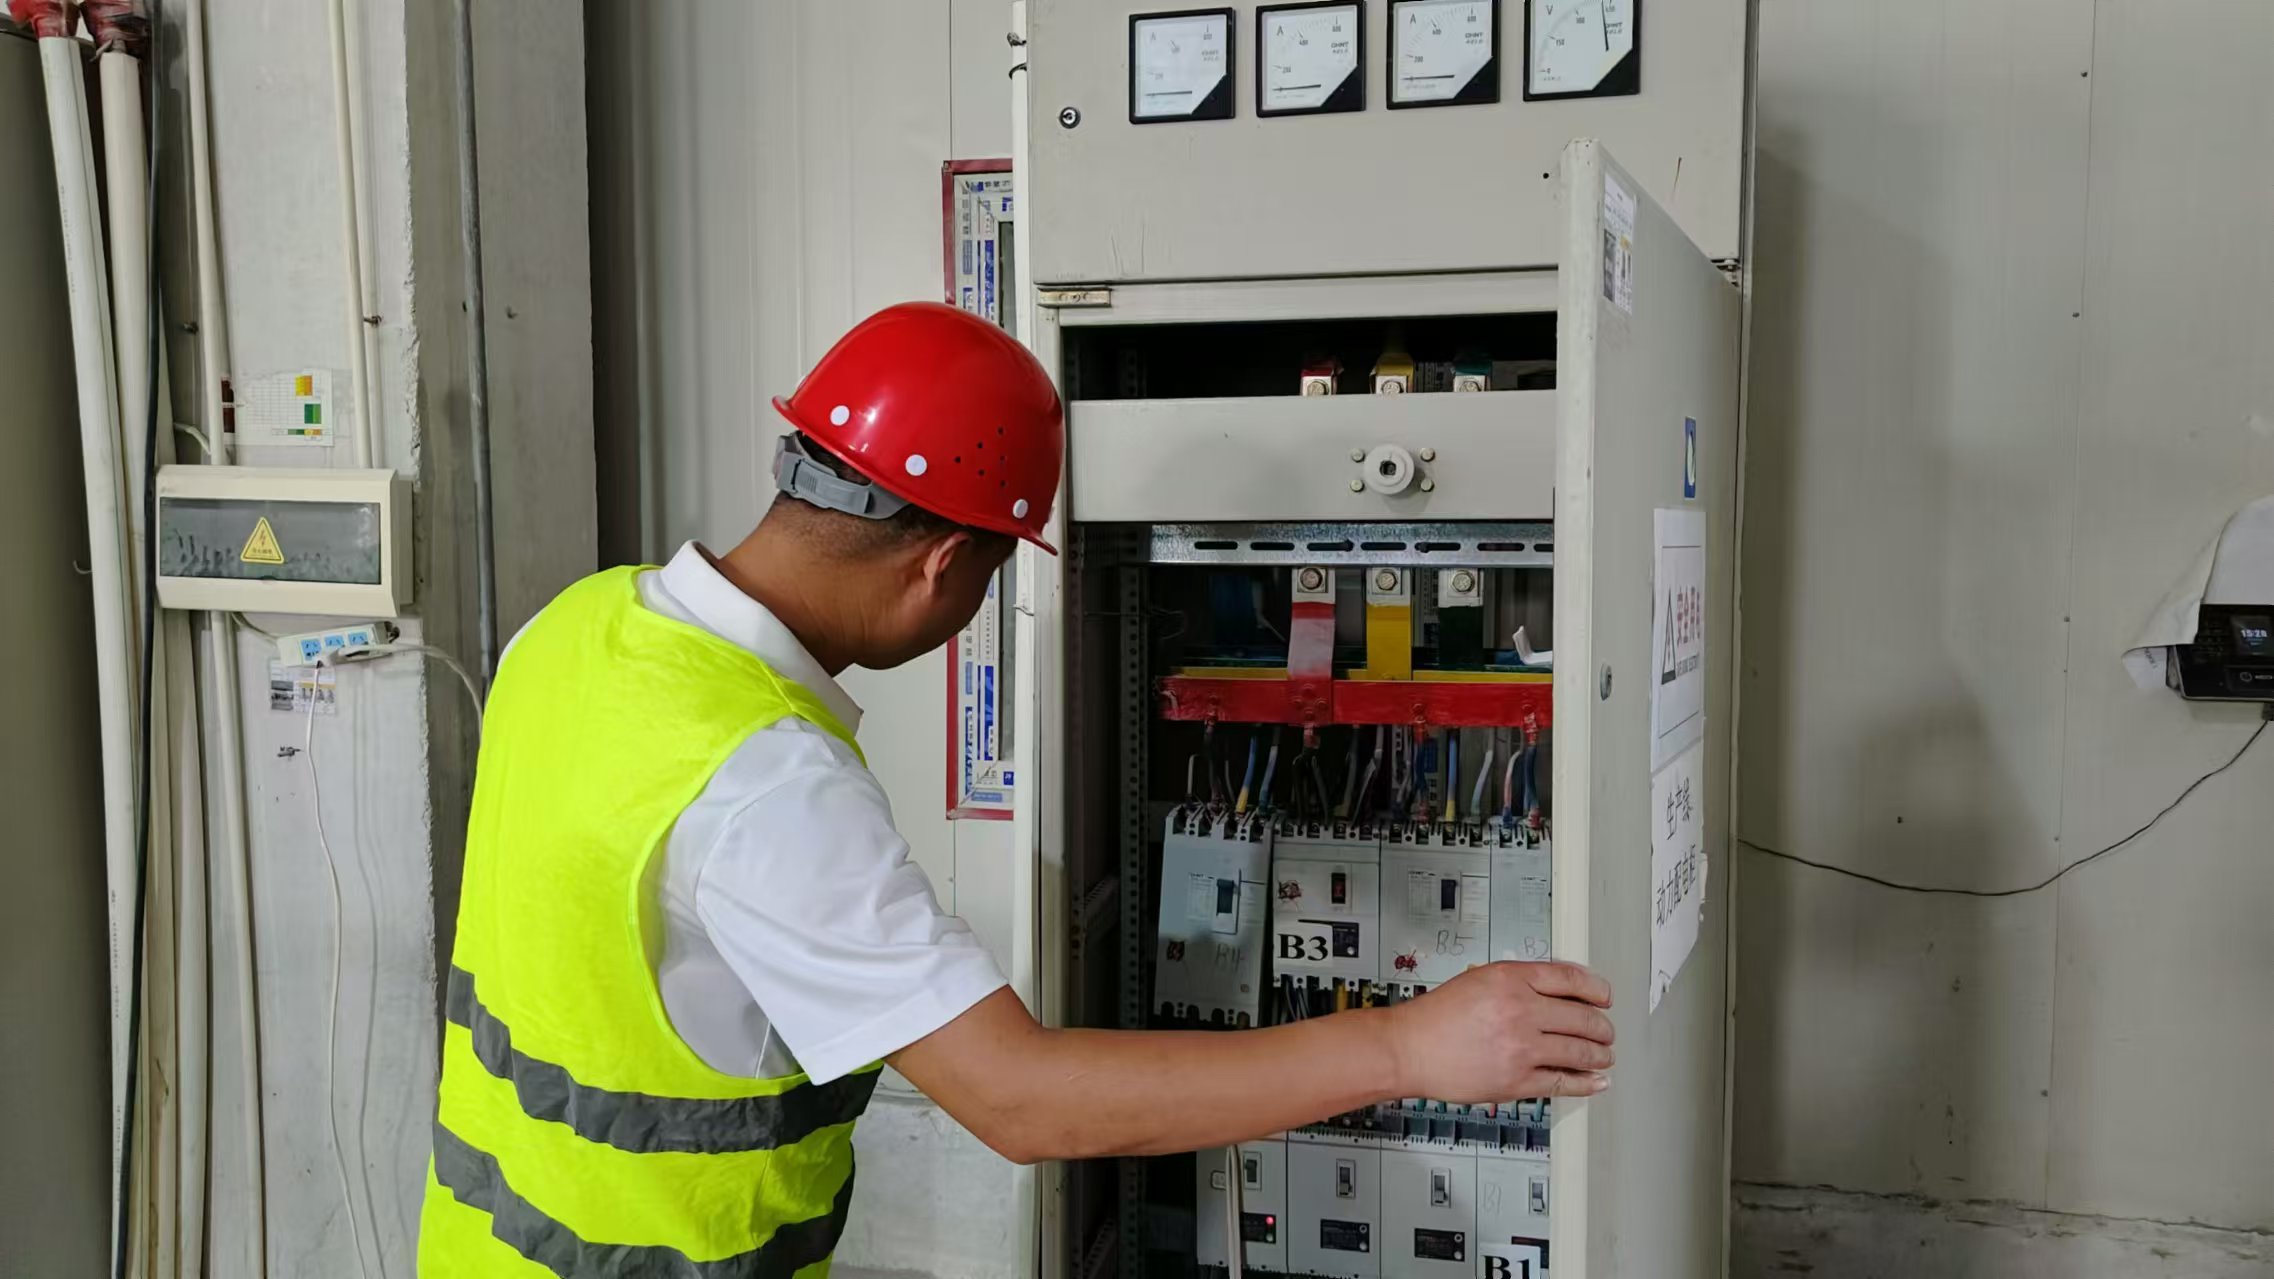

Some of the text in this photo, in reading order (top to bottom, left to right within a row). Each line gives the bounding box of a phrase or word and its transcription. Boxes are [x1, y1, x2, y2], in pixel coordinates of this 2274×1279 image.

[1410, 13, 1417, 24] A
[1546, 5, 1553, 15] V
[1276, 25, 1284, 36] A
[1666, 776, 1694, 841] 生产线
[1656, 844, 1696, 929] 动力配电柜
[1277, 933, 1328, 961] B3
[1482, 1255, 1531, 1279] B1
